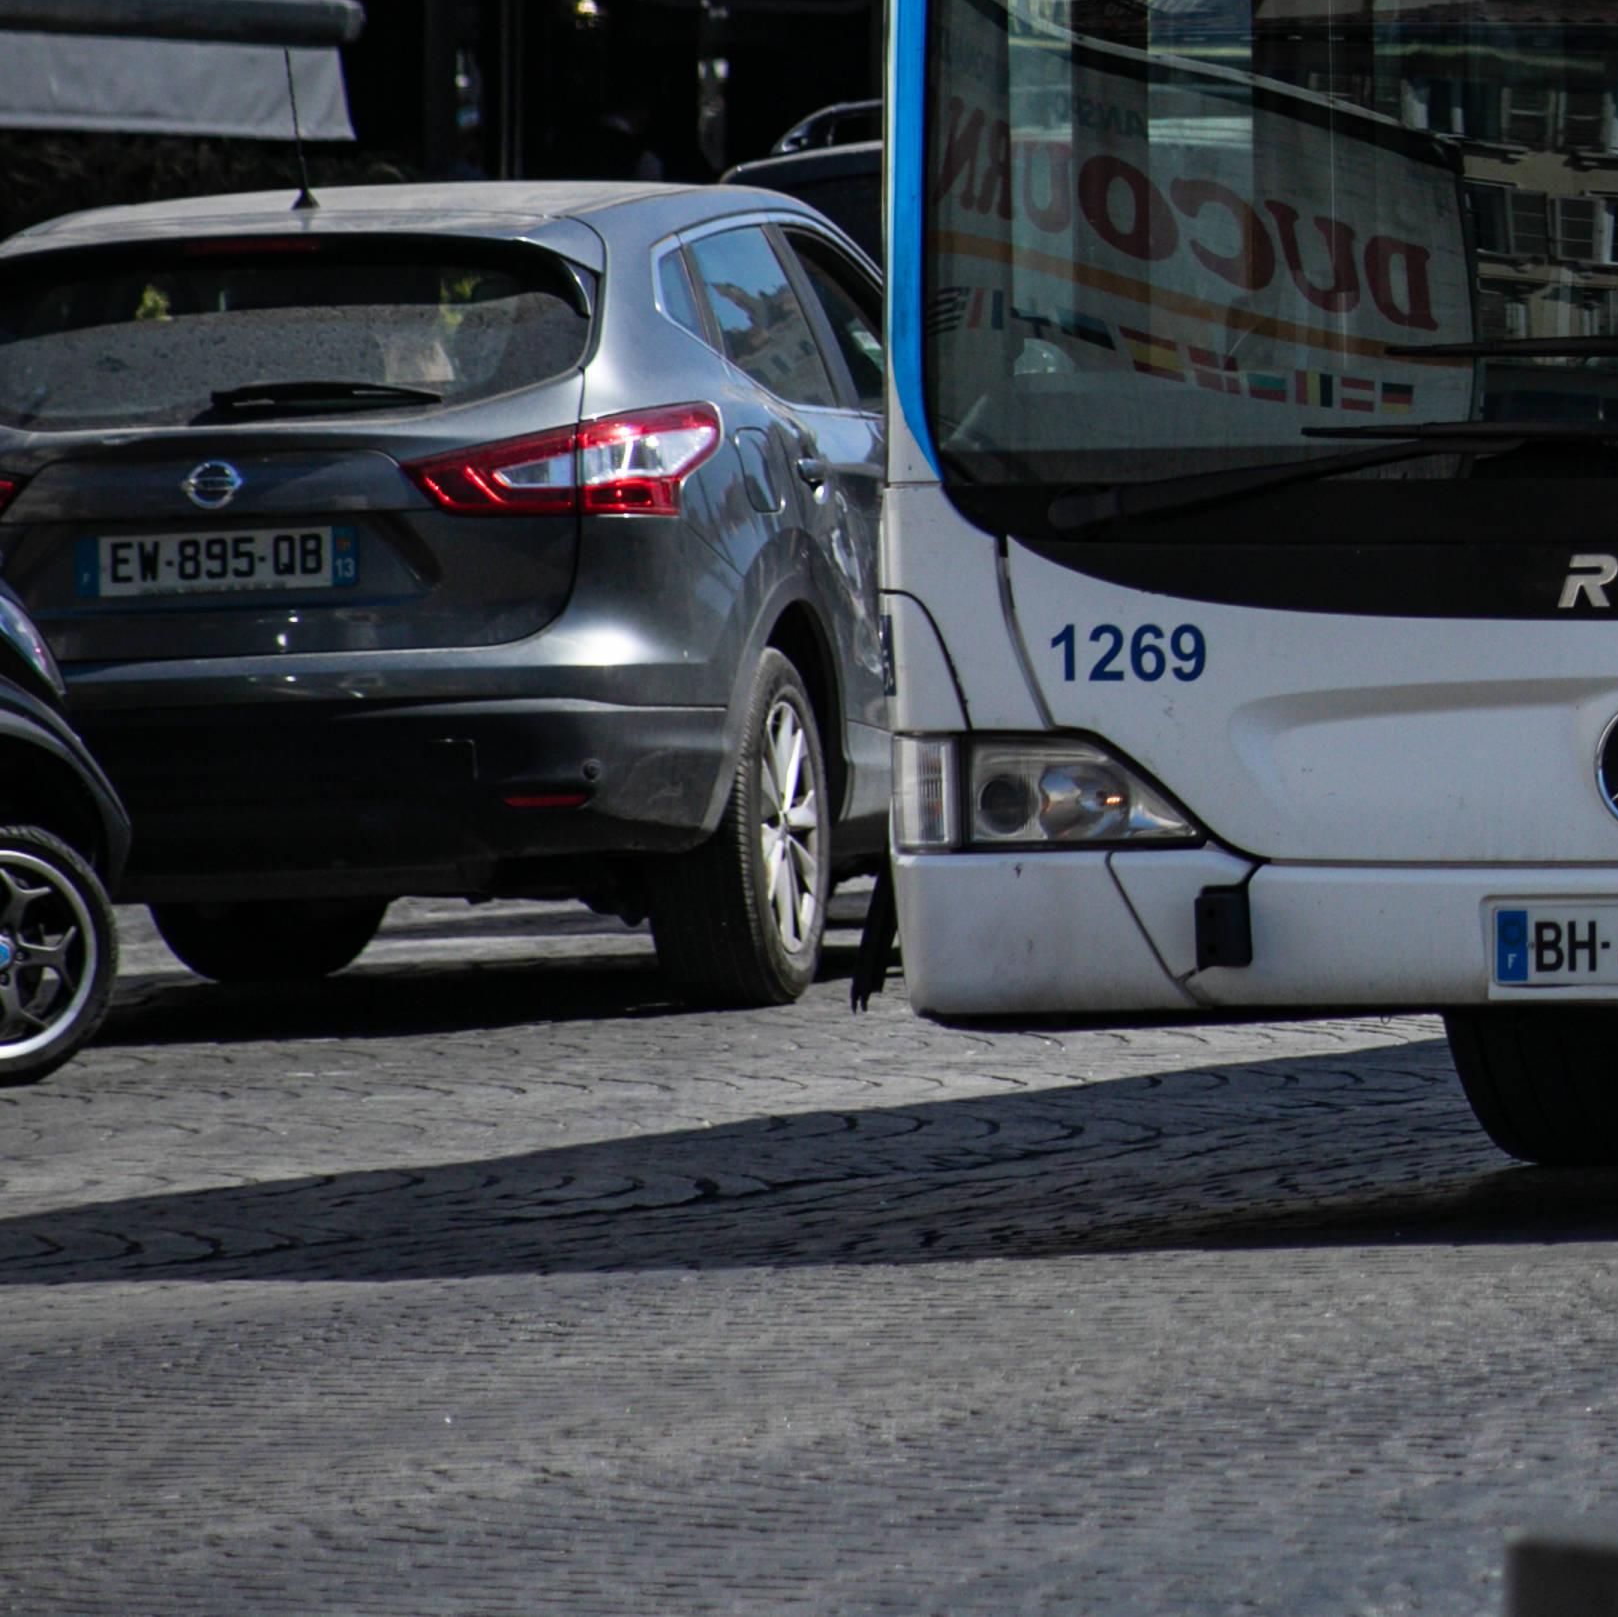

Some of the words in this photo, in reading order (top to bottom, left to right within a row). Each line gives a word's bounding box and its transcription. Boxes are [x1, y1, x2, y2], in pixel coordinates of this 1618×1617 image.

[110, 533, 323, 583] EW-895-QB
[335, 558, 355, 578] 13
[1051, 624, 1206, 682] 1269
[1507, 953, 1518, 969] F
